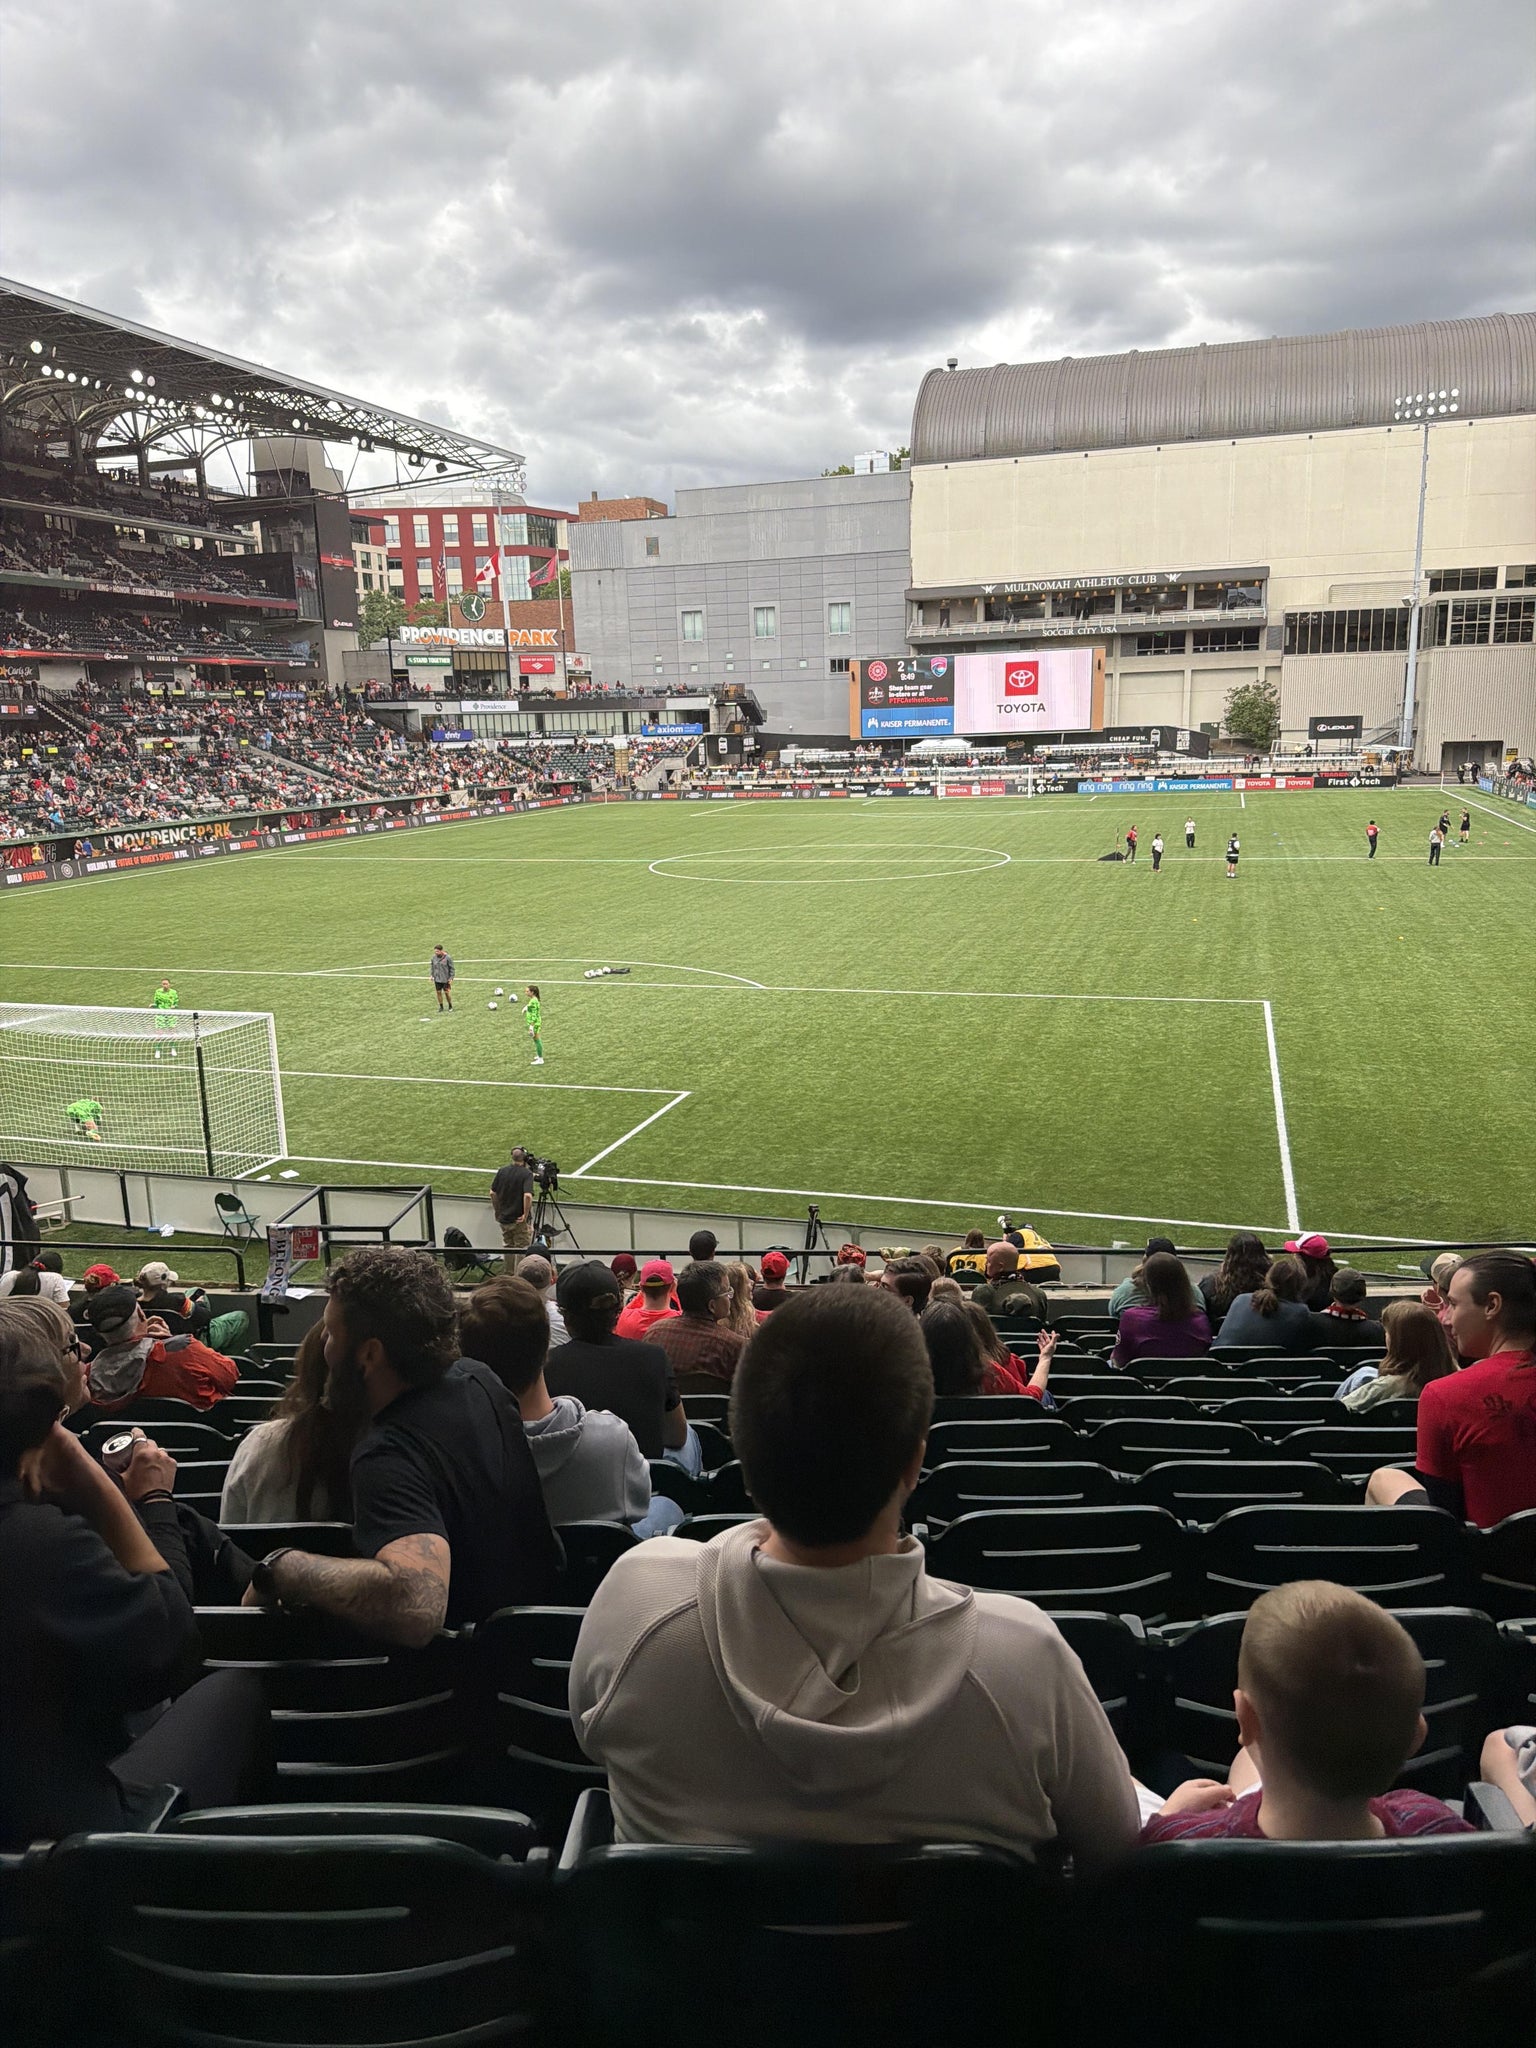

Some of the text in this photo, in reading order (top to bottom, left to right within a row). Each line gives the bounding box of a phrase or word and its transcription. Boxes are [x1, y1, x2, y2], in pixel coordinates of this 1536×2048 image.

[1004, 574, 1157, 593] MULTNOMAH ATHLETIC CLUB
[155, 589, 175, 599] SINCLAIR
[1042, 626, 1117, 637] SOCCER CITY USA
[399, 626, 559, 647] PROVIDENCE PARK
[898, 659, 918, 672] 2 1
[996, 703, 1046, 714] TOYOTA
[657, 725, 684, 733] axiom
[444, 731, 460, 740] xfinity
[1328, 777, 1381, 786] First Tech
[1080, 784, 1095, 792] ring
[1098, 784, 1112, 792] ring
[1119, 782, 1134, 791] ring
[1138, 782, 1153, 791] ring
[870, 788, 893, 796] Alaska
[6, 874, 22, 884] BUILD
[270, 1240, 286, 1297] BELONG
